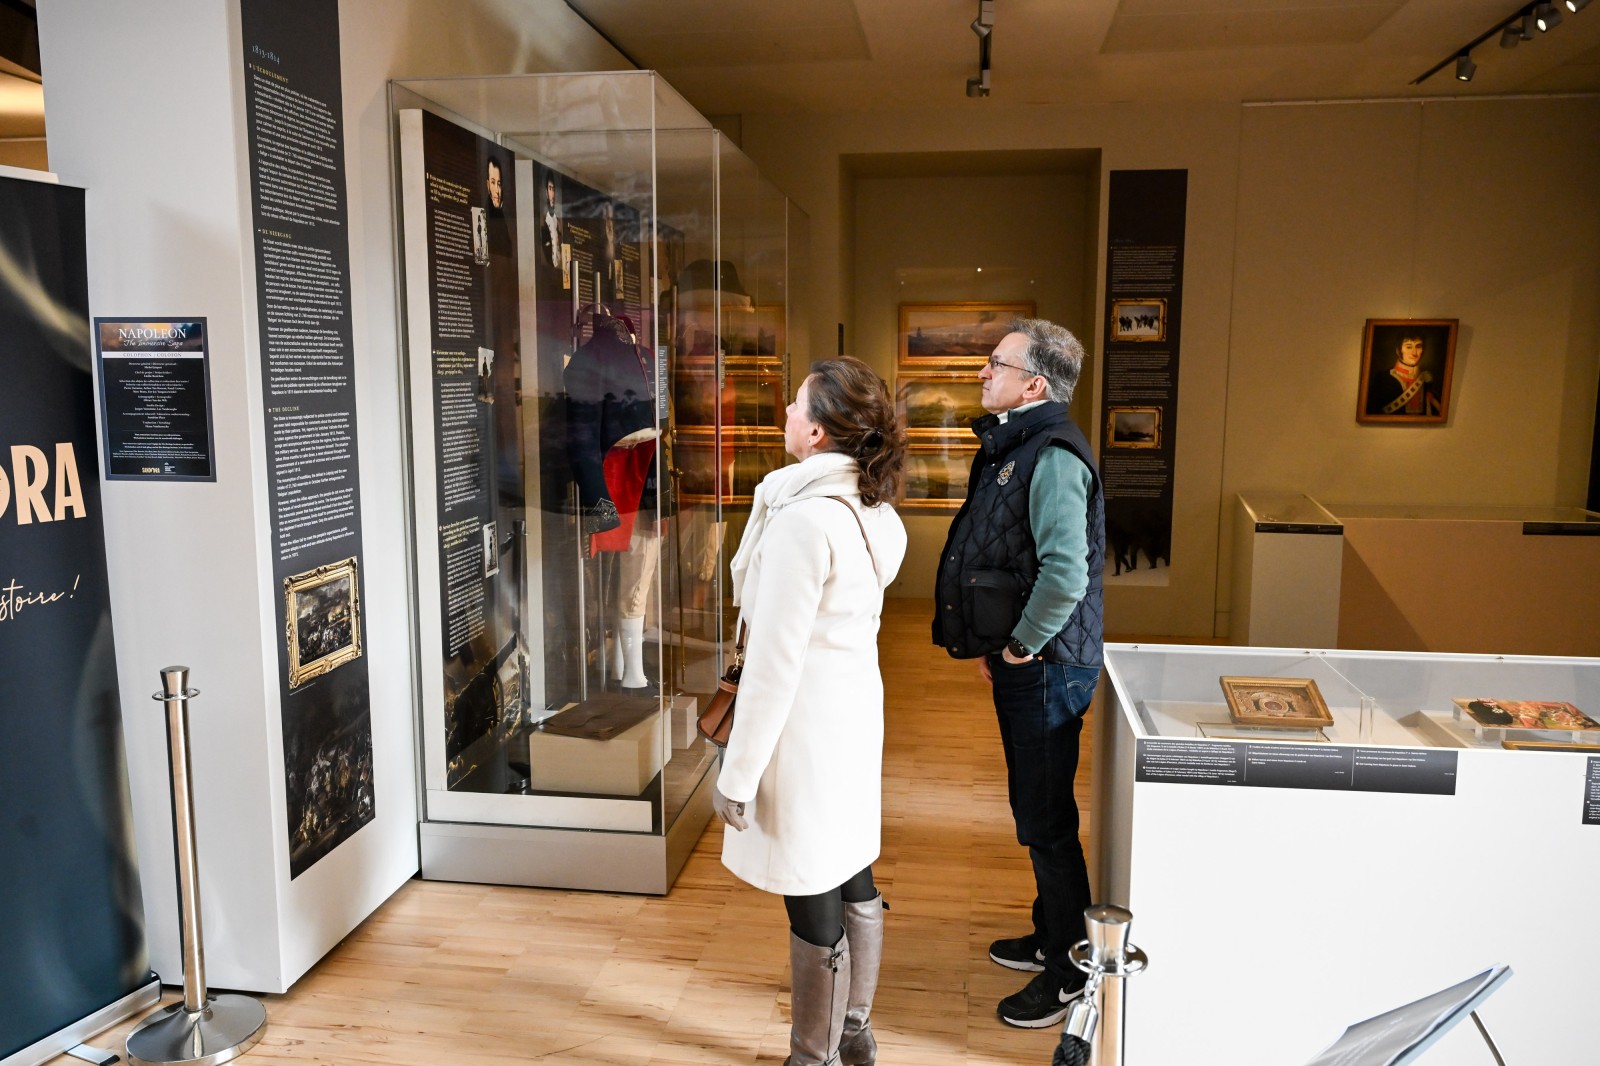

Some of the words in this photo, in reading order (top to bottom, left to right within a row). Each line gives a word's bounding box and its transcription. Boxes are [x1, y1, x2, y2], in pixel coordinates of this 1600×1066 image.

[119, 328, 186, 339] NAPOLEON
[168, 340, 183, 349] Saga
[0, 442, 87, 525] RA
